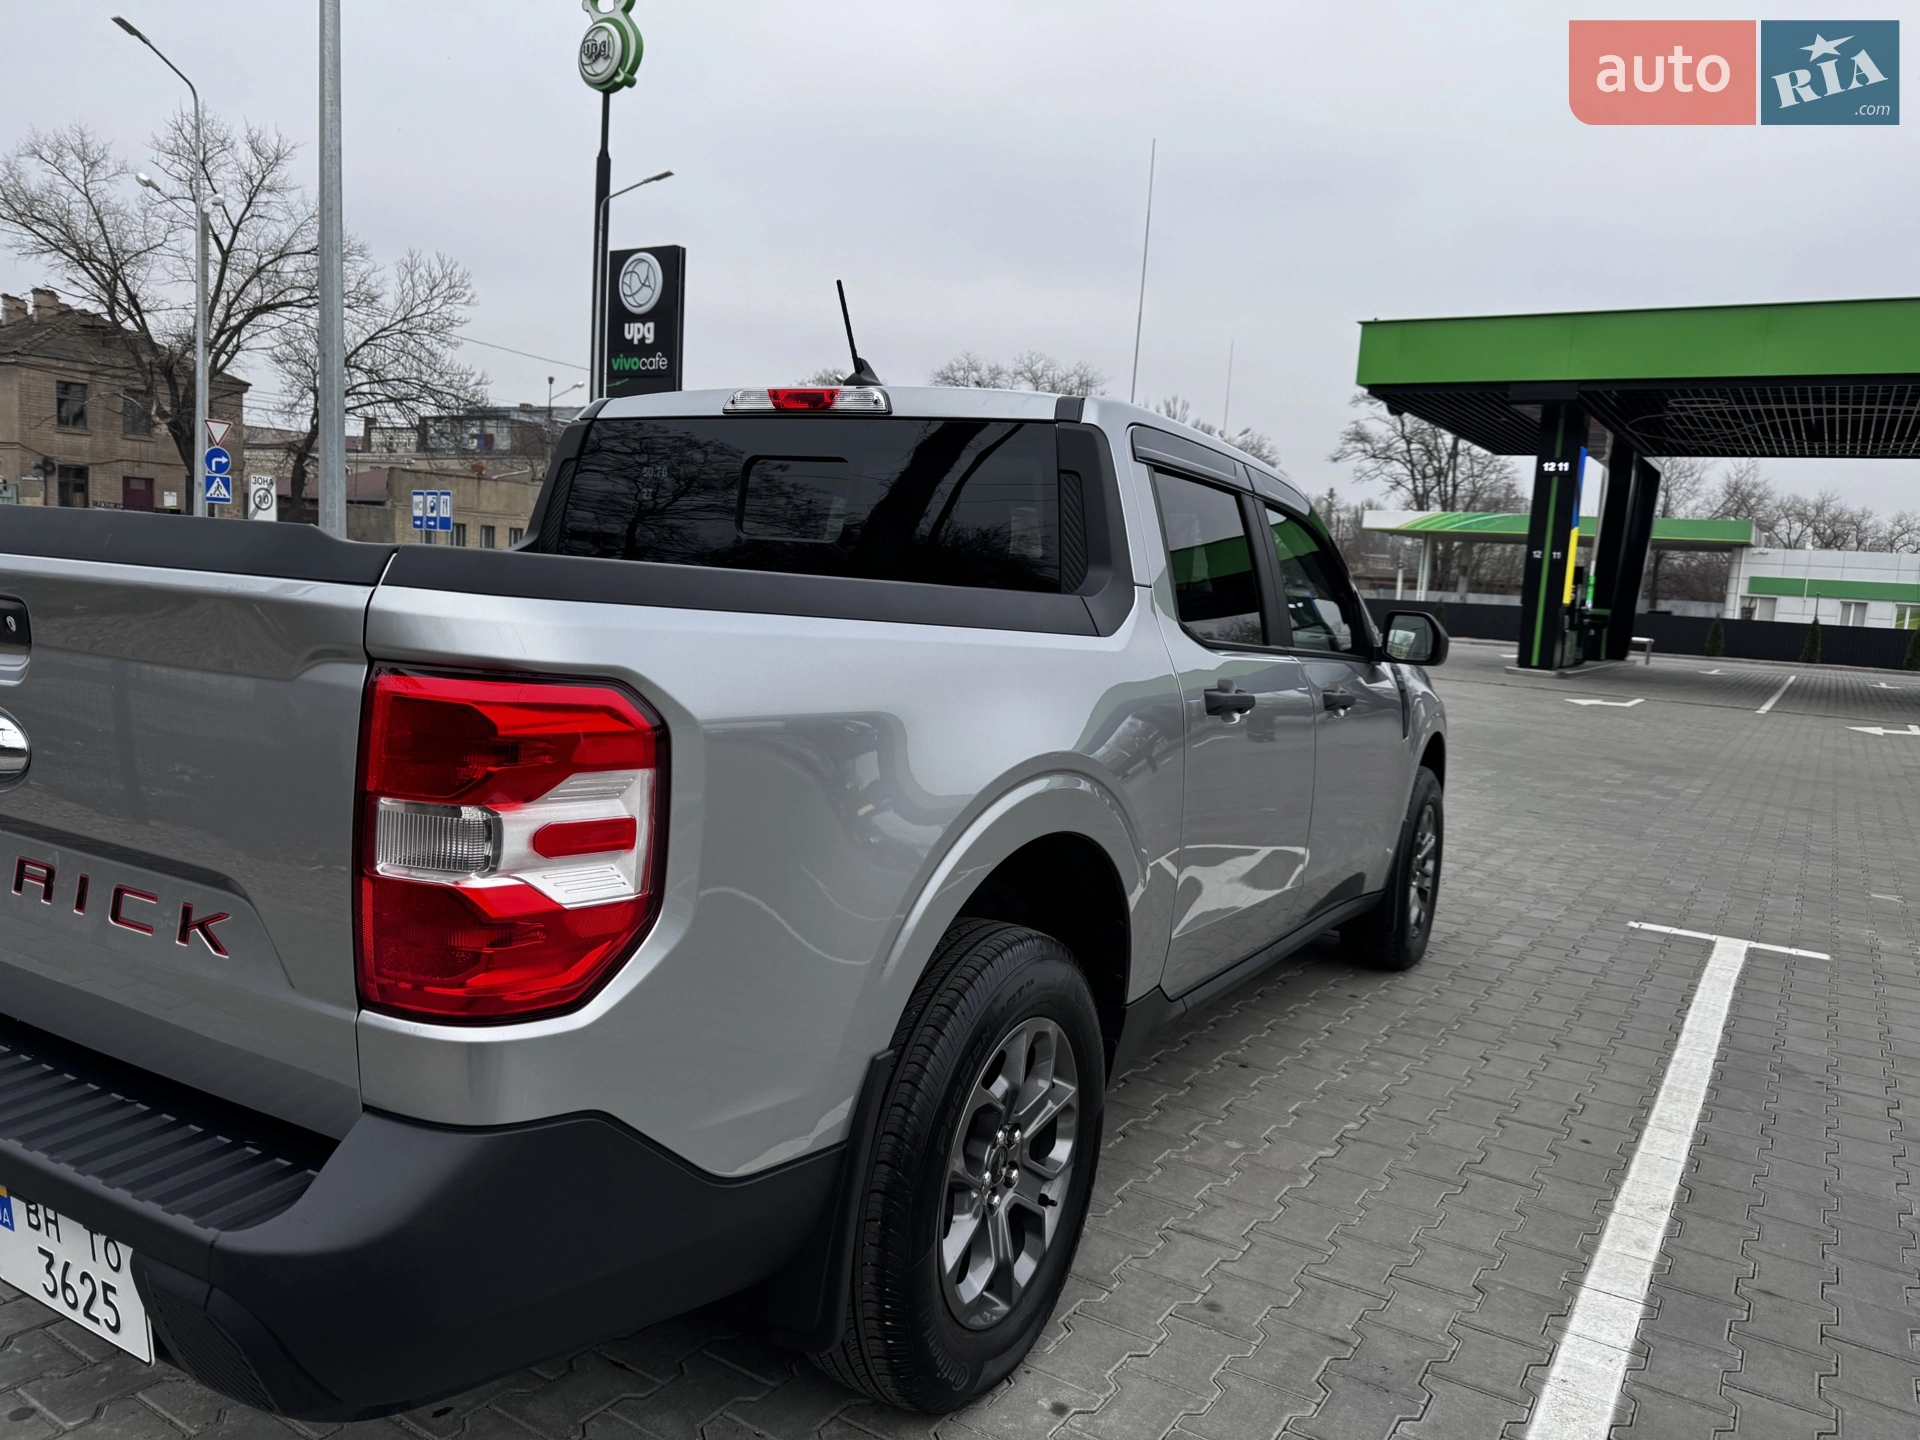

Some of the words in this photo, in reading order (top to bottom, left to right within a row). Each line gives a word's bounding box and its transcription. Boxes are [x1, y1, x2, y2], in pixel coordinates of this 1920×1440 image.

[582, 39, 610, 60] upg
[624, 321, 655, 345] upg
[611, 351, 668, 371] vivocafe
[1542, 462, 1556, 471] 12
[1557, 462, 1569, 471] 11
[252, 475, 274, 486] ЗОНА
[1532, 550, 1542, 558] 12
[26, 1201, 62, 1244] BH
[37, 1245, 121, 1334] 3625
